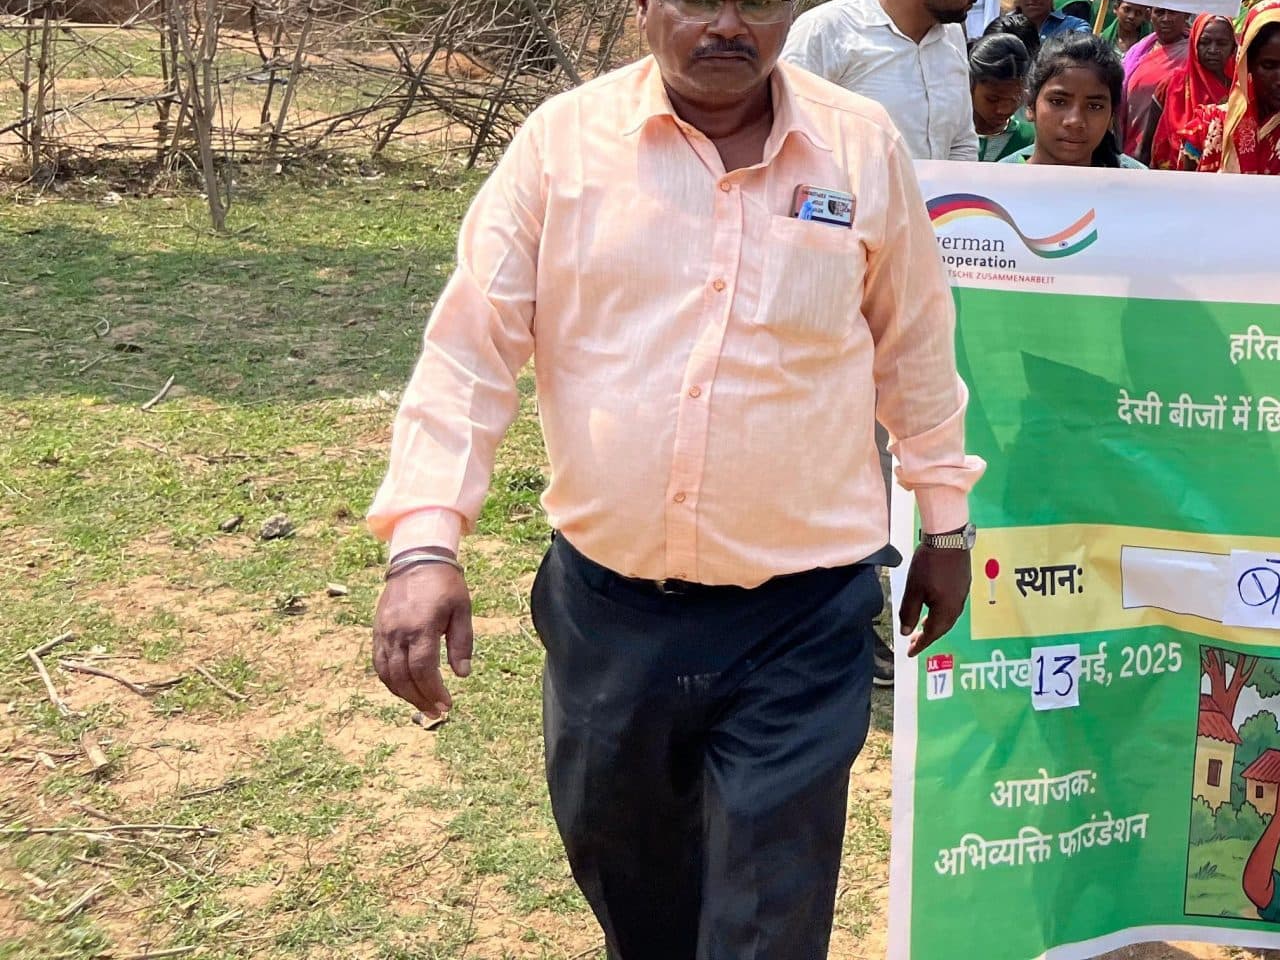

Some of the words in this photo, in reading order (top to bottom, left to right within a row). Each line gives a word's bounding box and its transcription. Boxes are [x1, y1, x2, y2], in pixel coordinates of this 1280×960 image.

[942, 255, 1016, 269] operation
[947, 270, 973, 279] TSCHE
[976, 272, 1055, 284] ZUSAMMENARBEIT
[1118, 389, 1162, 426] देसी
[1169, 393, 1227, 430] बीजों
[1232, 396, 1253, 431] में
[1014, 564, 1084, 597] स्थान:
[933, 673, 947, 694] 17
[1034, 655, 1077, 697] 13
[1119, 642, 1182, 678] 2025
[990, 768, 1097, 808] आयोजक:
[934, 825, 1053, 876] अभिव्यक्ति
[1058, 811, 1149, 858] फाउंडेशन
